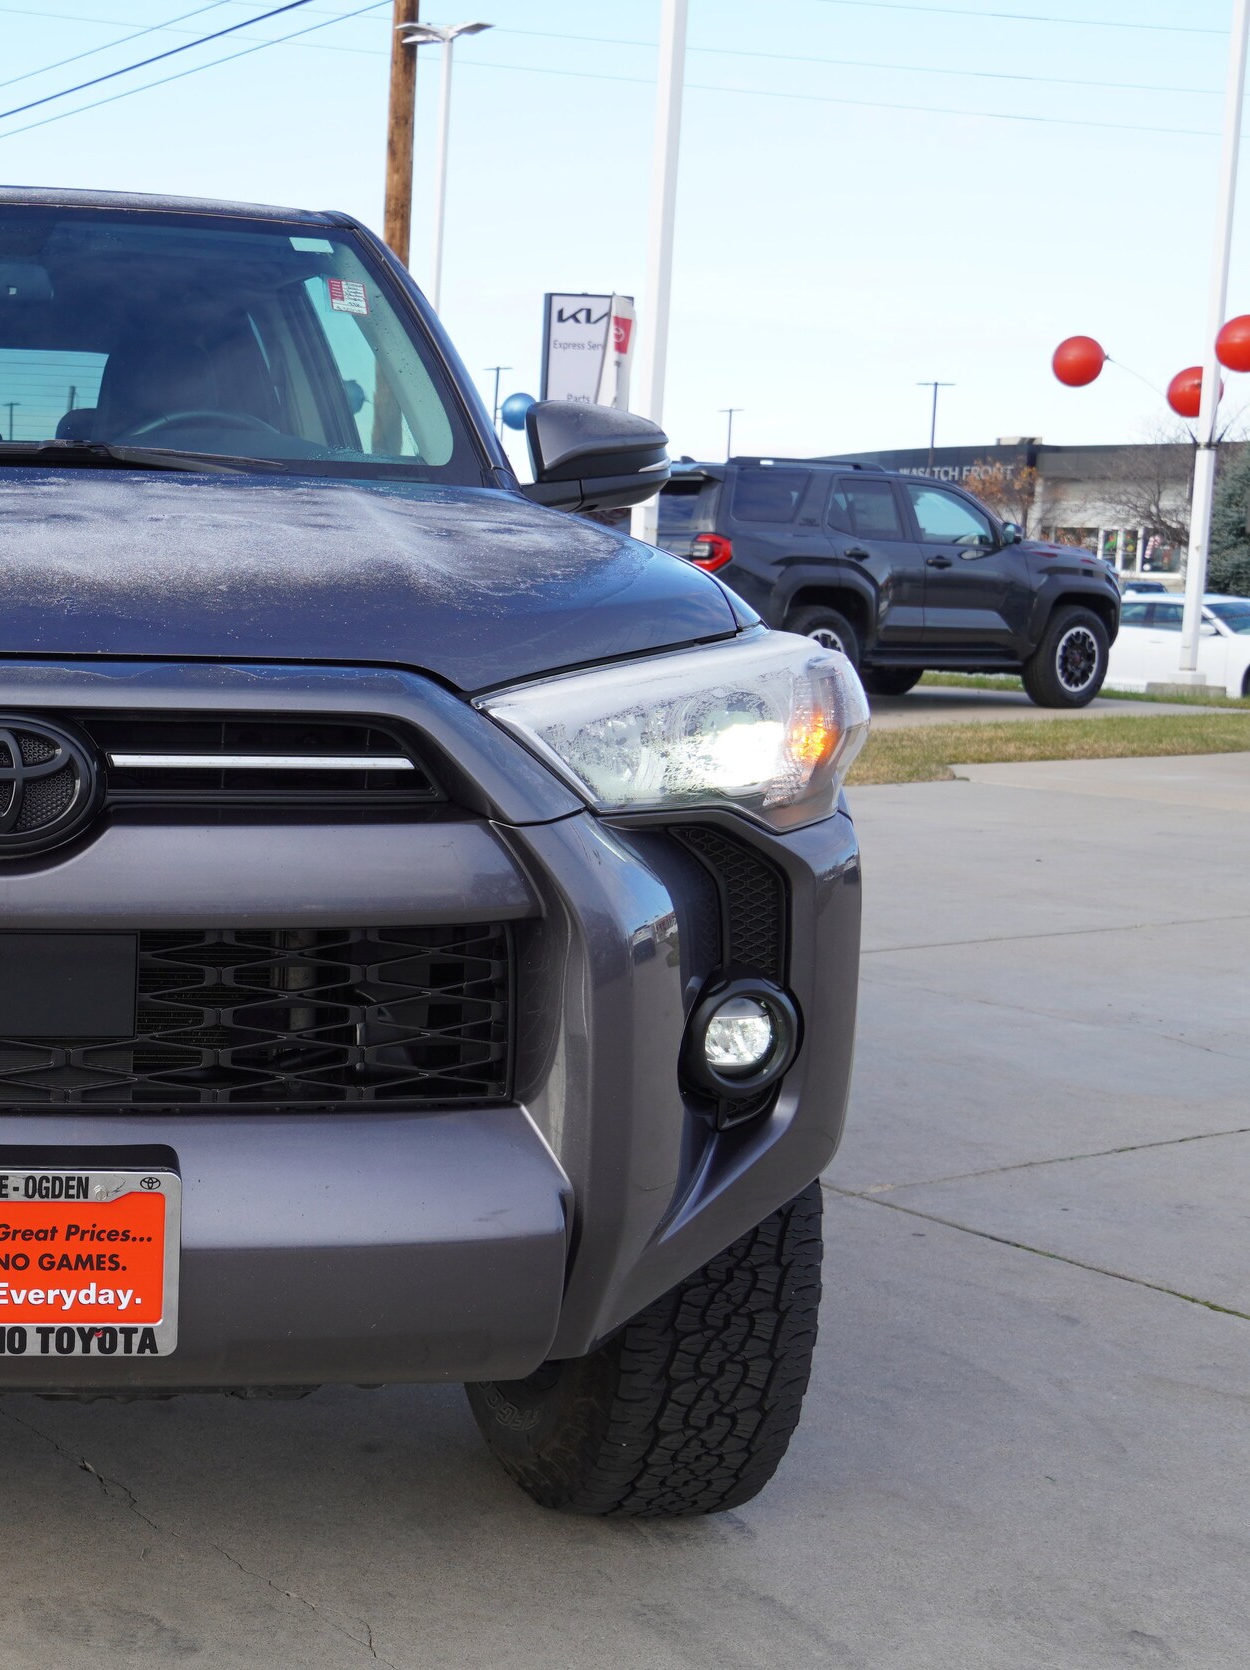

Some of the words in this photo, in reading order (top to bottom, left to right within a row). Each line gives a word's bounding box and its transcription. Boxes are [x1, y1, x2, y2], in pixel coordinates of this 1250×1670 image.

[553, 339, 585, 351] Express
[587, 341, 605, 351] Ser
[566, 393, 590, 403] Parts
[23, 1176, 90, 1200] OGDEN
[65, 1223, 152, 1243] Prices...
[38, 1254, 127, 1271] GAMES.
[36, 1327, 158, 1355] TOYOTA
